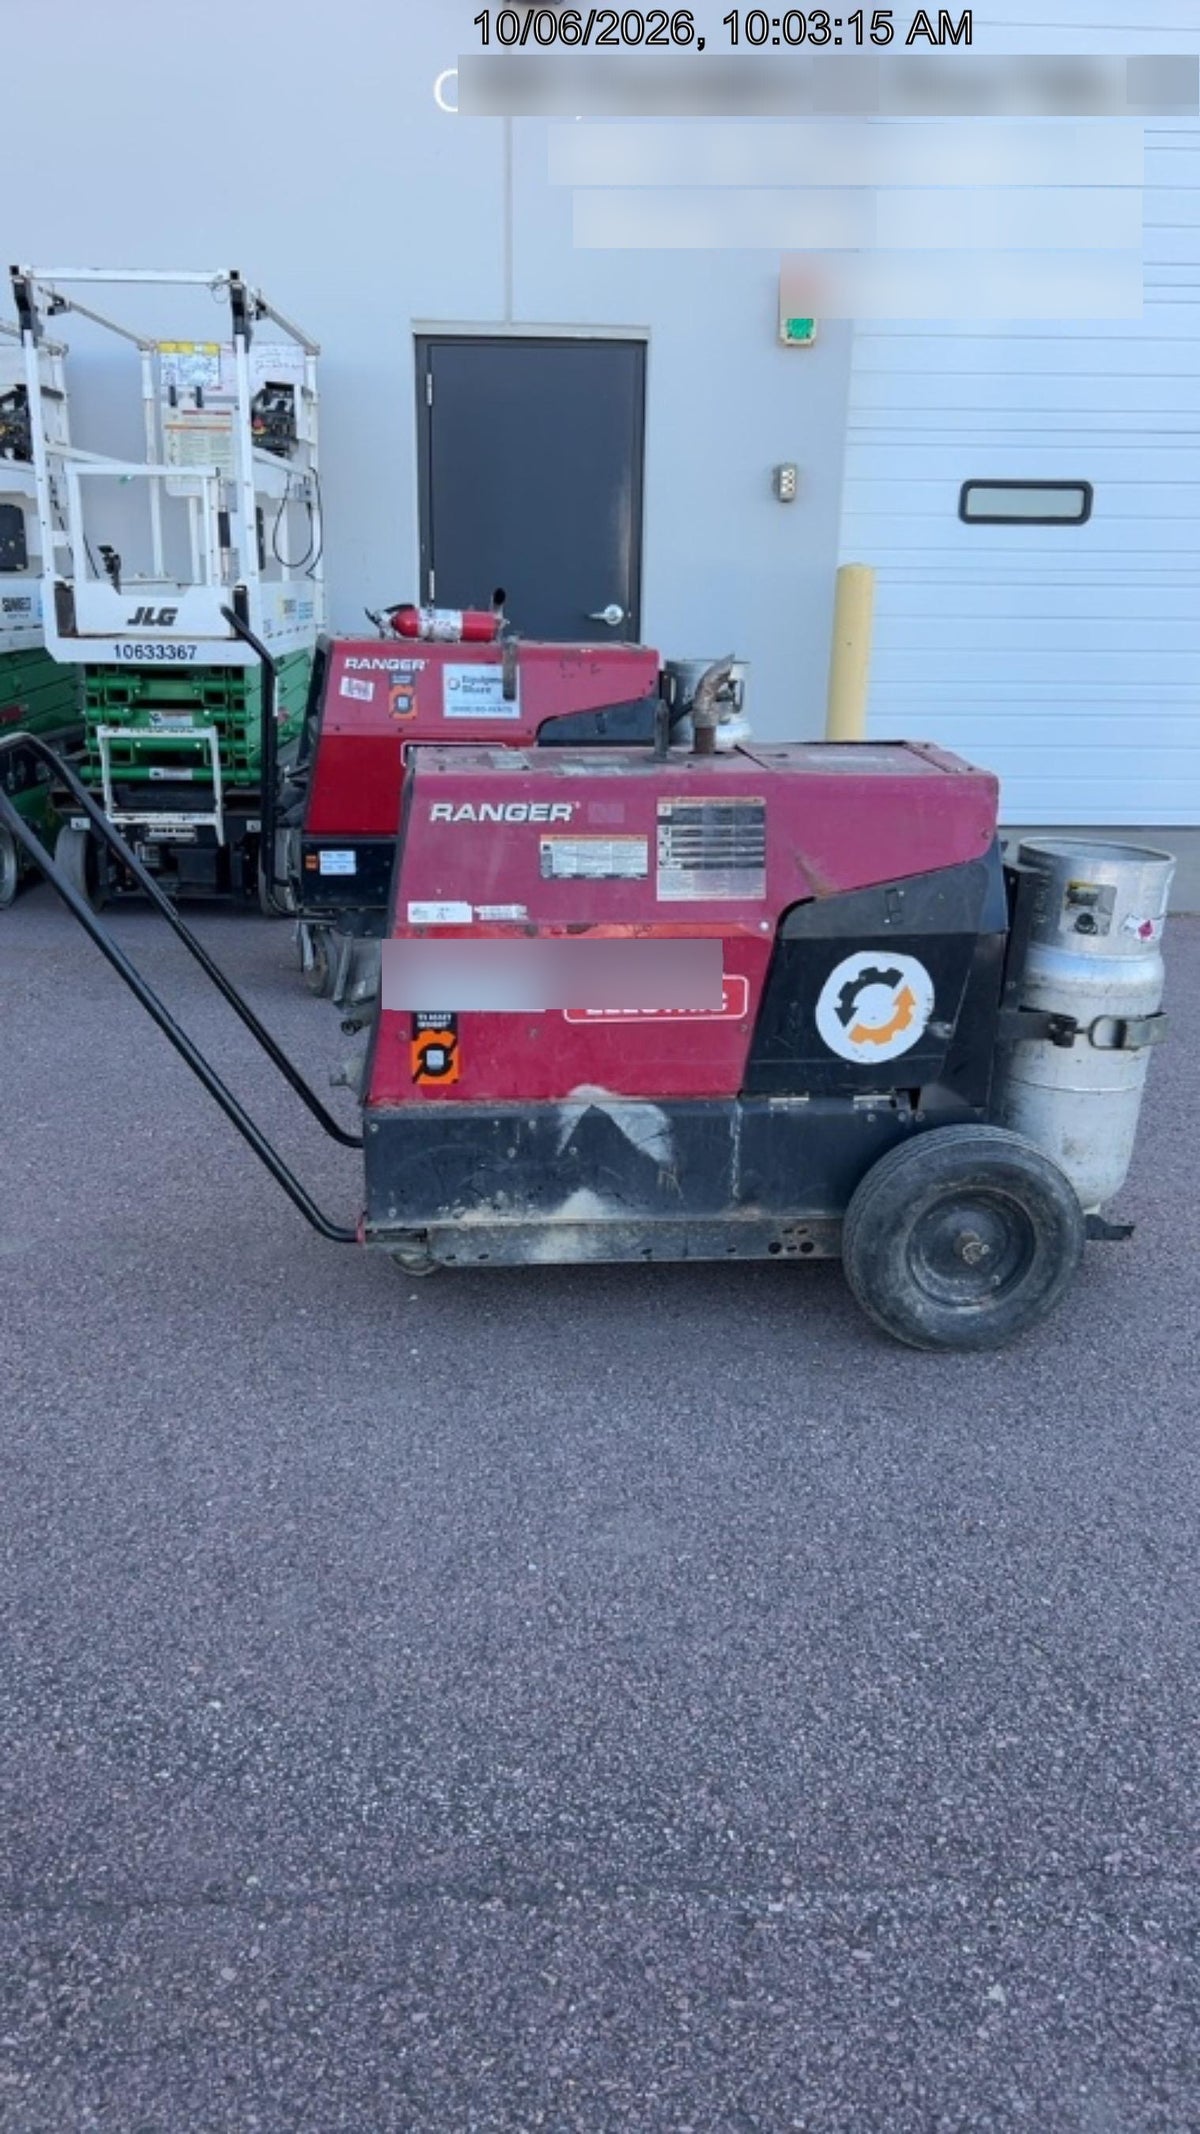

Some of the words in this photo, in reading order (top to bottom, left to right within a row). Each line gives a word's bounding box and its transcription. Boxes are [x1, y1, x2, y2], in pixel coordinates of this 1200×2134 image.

[126, 606, 179, 627] JLG
[113, 643, 198, 661] 10633367
[344, 658, 425, 672] RANGER
[429, 803, 573, 822] RANGER
